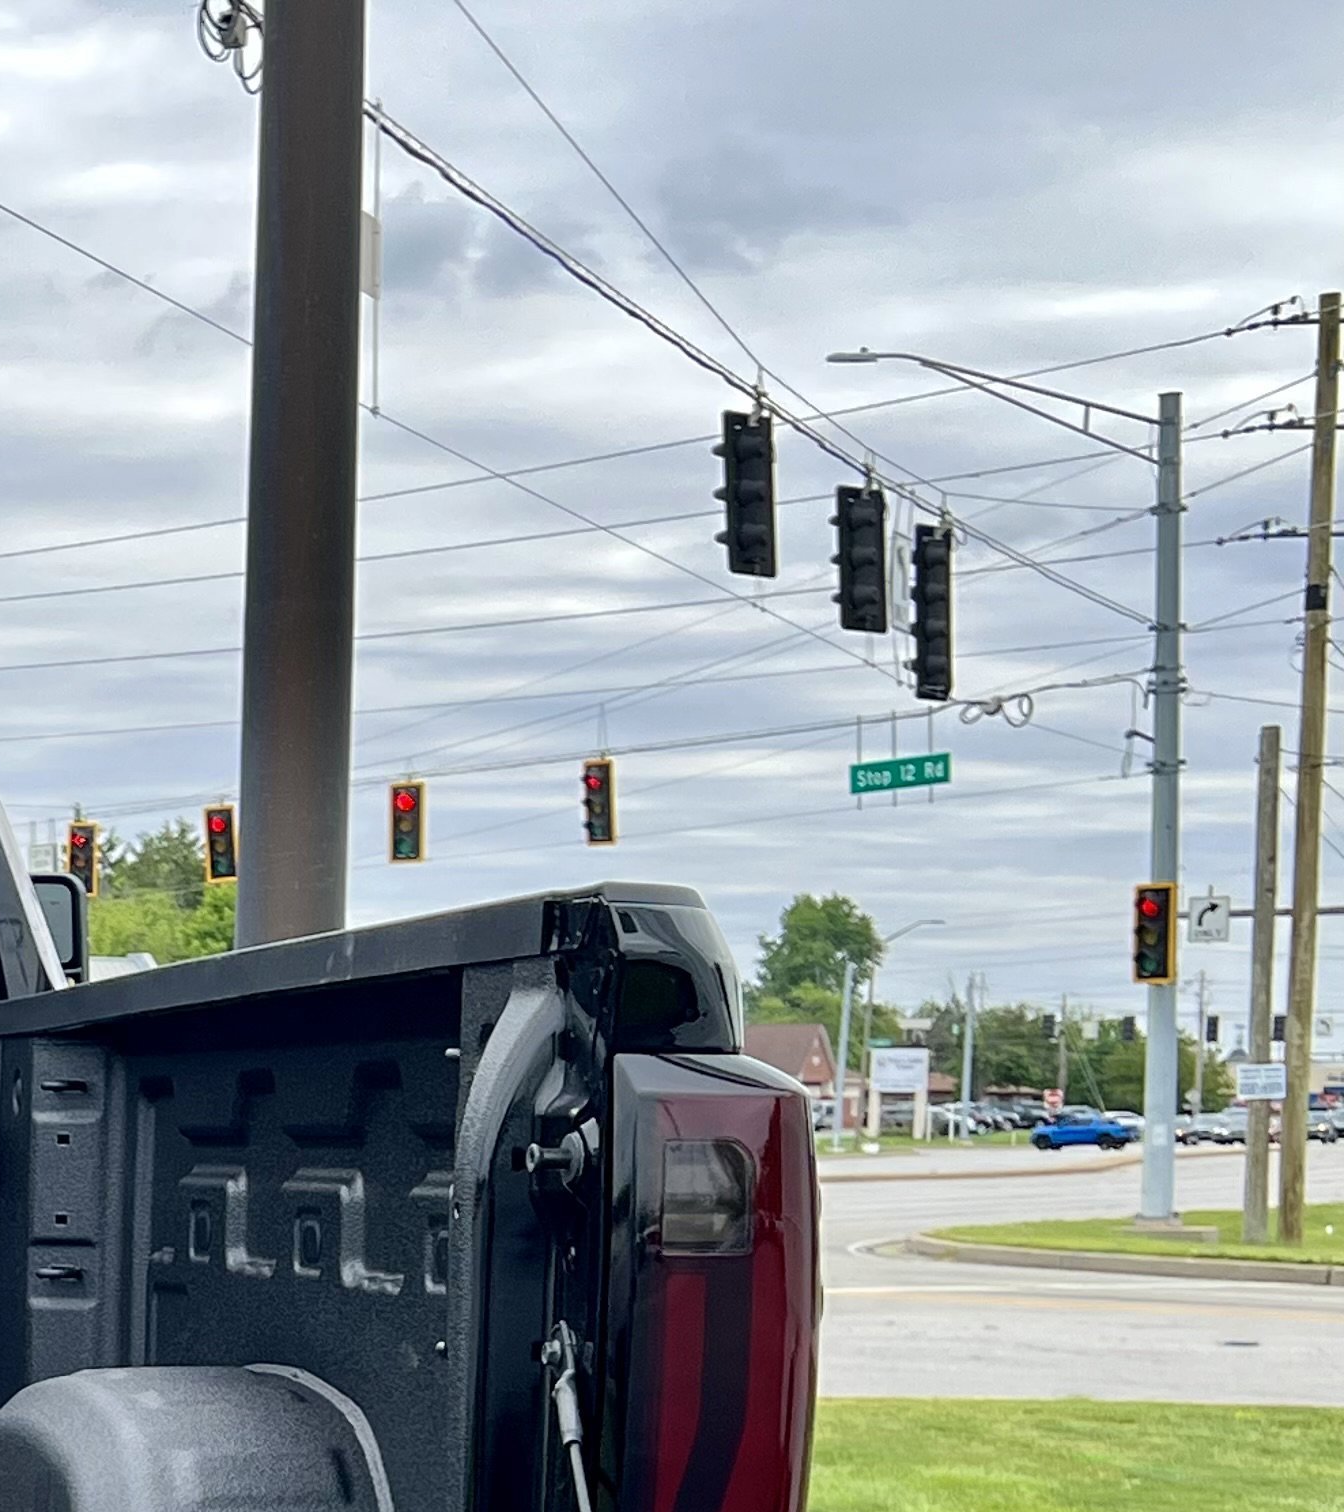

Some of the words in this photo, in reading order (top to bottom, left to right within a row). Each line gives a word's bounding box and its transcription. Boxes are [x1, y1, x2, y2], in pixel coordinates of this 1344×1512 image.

[857, 770, 892, 787] Stop
[900, 764, 916, 781] 12
[924, 760, 945, 779] Rd
